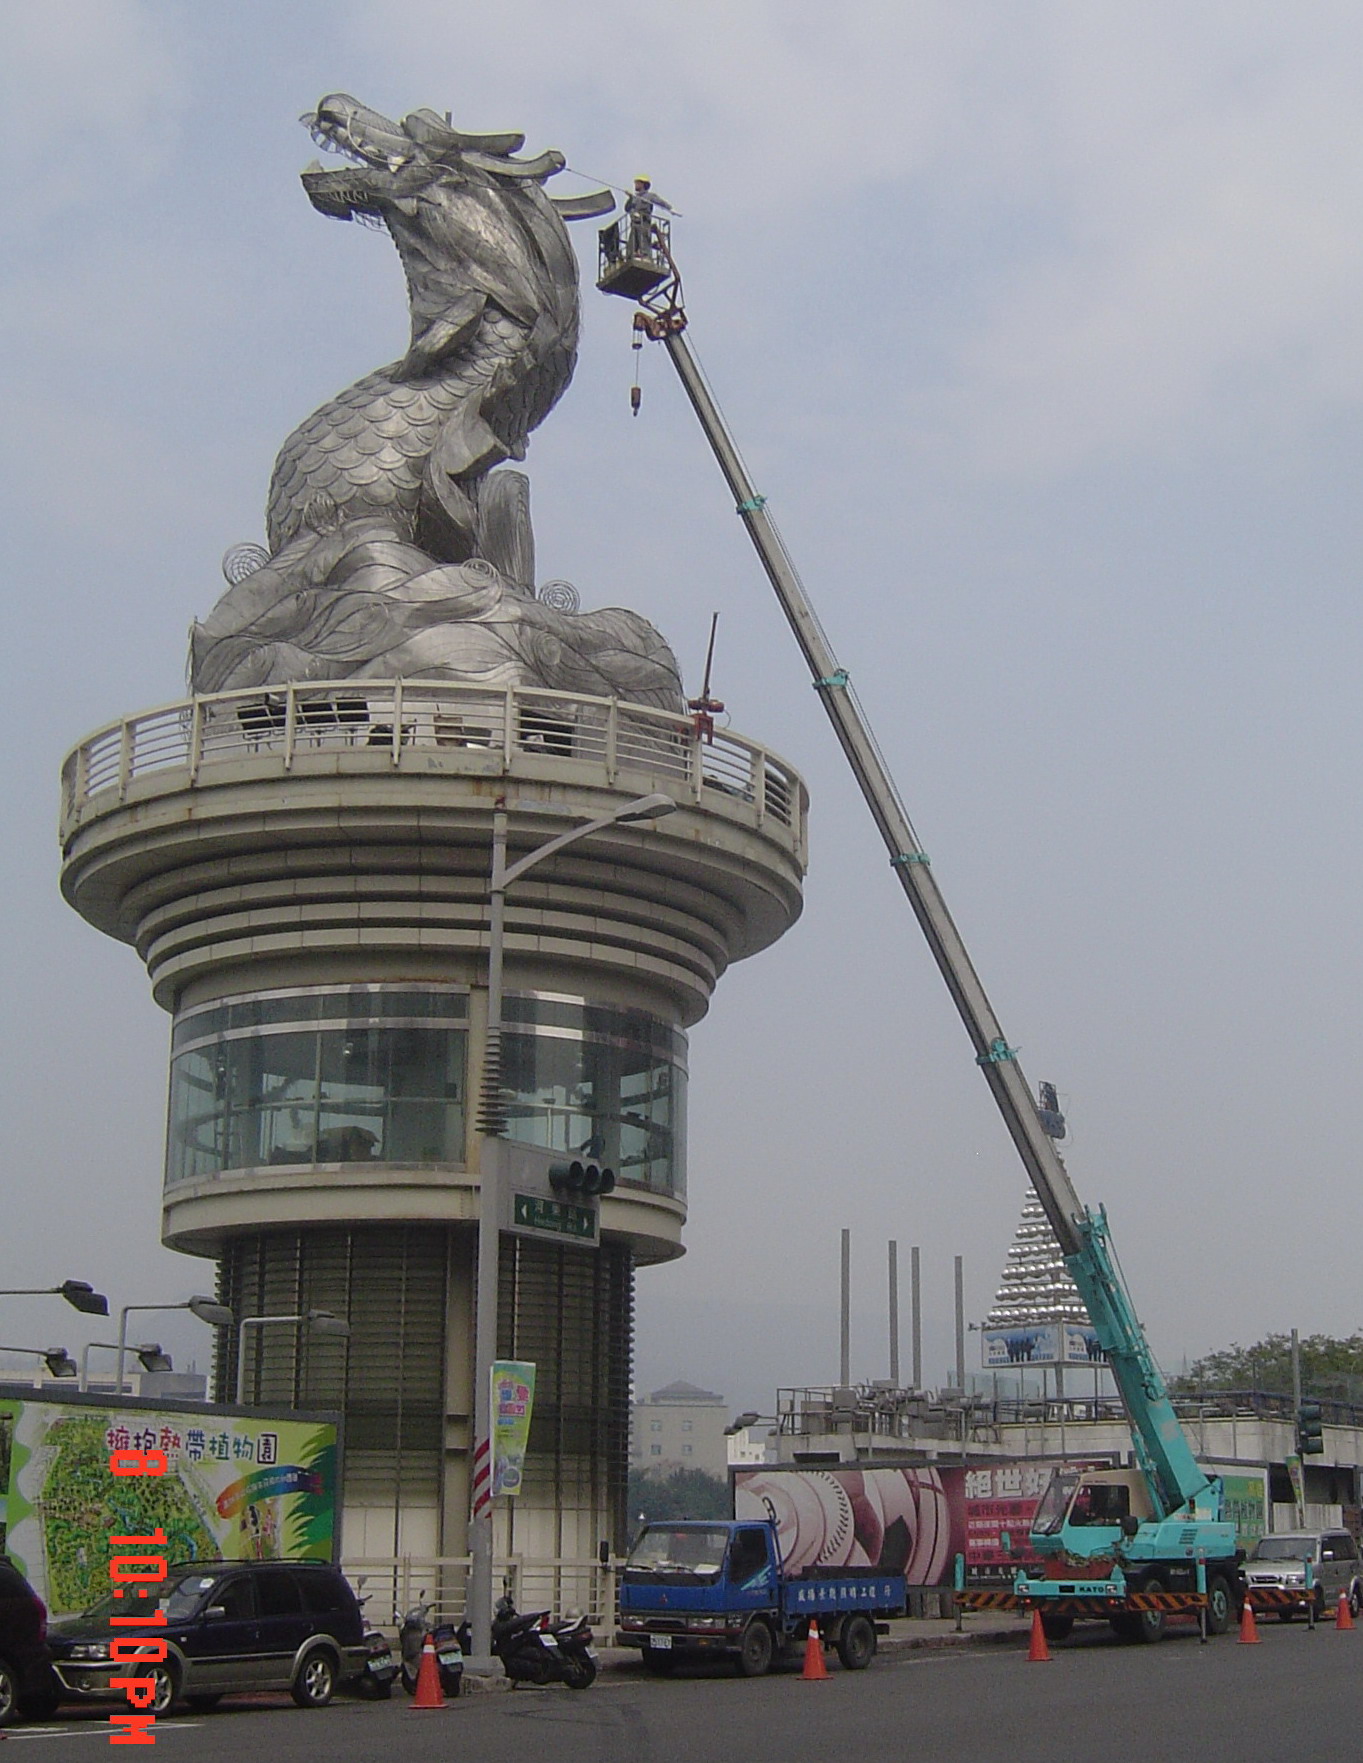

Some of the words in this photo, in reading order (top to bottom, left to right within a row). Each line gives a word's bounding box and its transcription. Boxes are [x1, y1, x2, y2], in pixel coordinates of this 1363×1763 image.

[107, 1425, 278, 1465] 擁抱熱帶植物園
